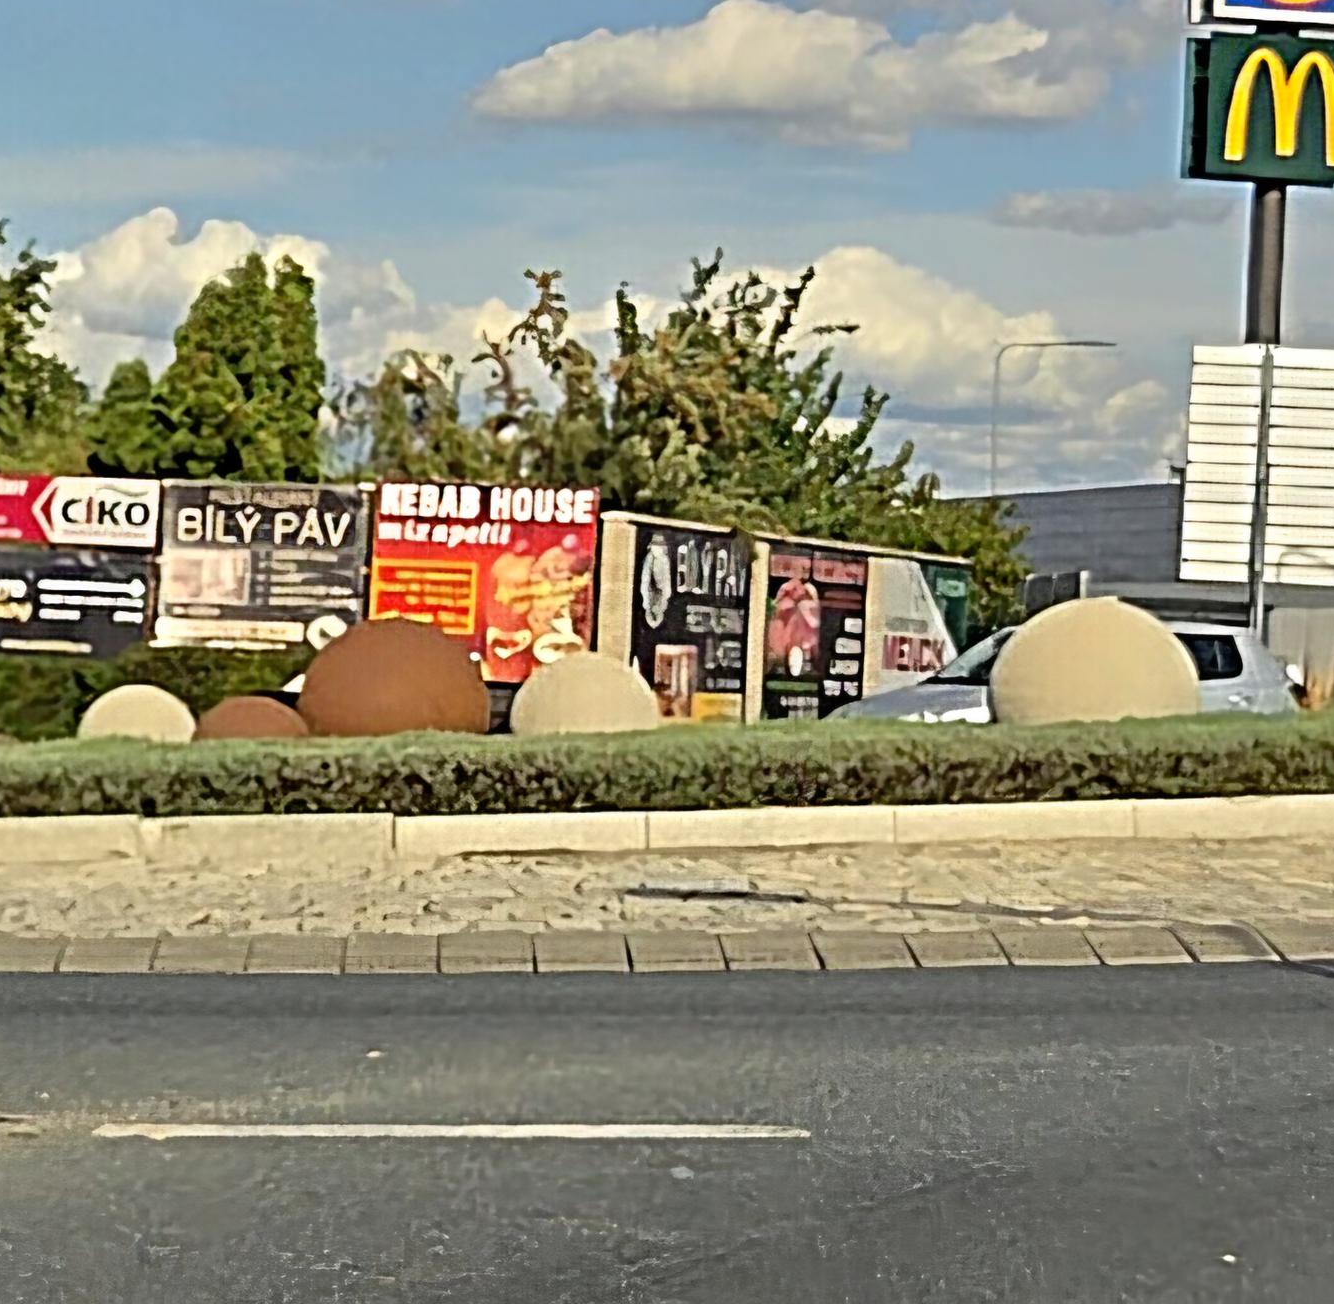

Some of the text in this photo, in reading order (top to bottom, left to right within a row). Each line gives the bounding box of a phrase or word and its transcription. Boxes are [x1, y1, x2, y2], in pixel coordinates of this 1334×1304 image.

[61, 496, 150, 526] CIKO
[380, 482, 595, 524] KEBAB HOUSE
